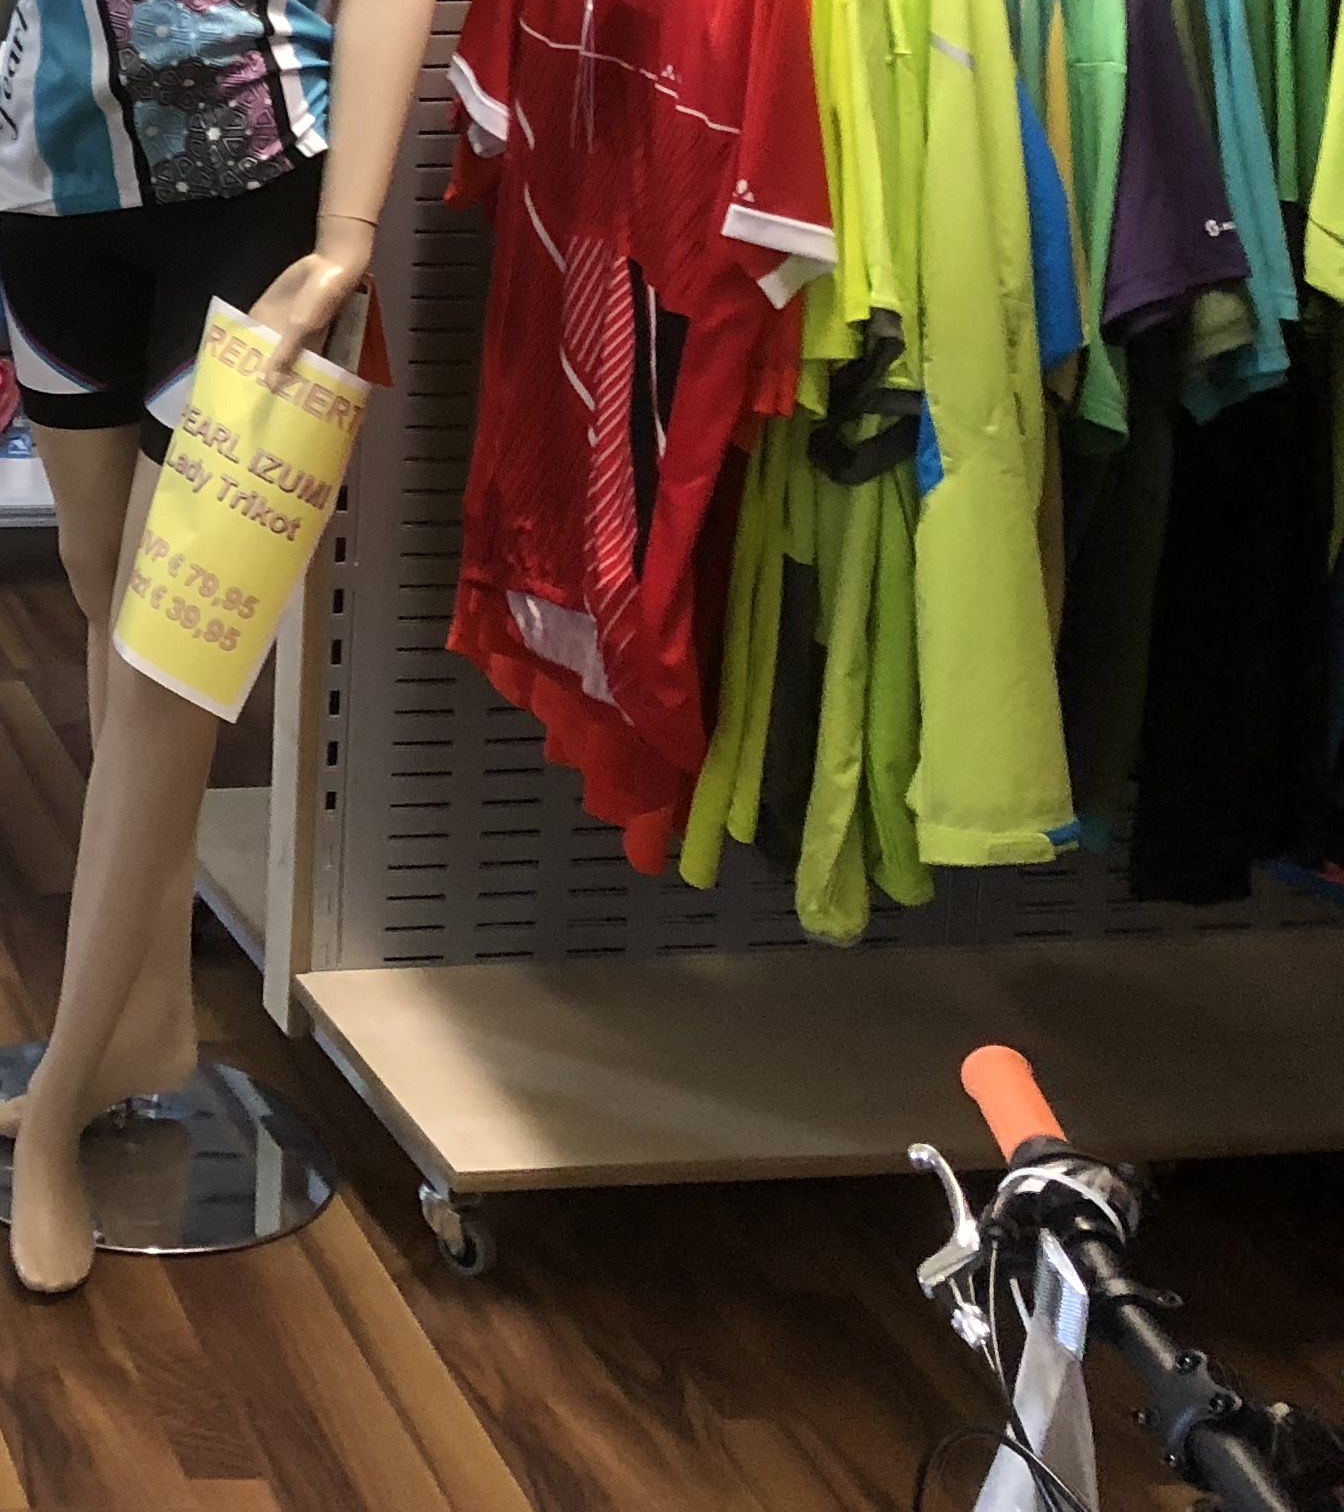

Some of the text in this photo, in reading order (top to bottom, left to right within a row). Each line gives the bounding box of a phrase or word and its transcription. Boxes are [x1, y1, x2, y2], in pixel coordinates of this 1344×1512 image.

[165, 440, 302, 542] Lady Trikot
[184, 562, 261, 620] 79,95
[165, 595, 241, 652] 39,95
